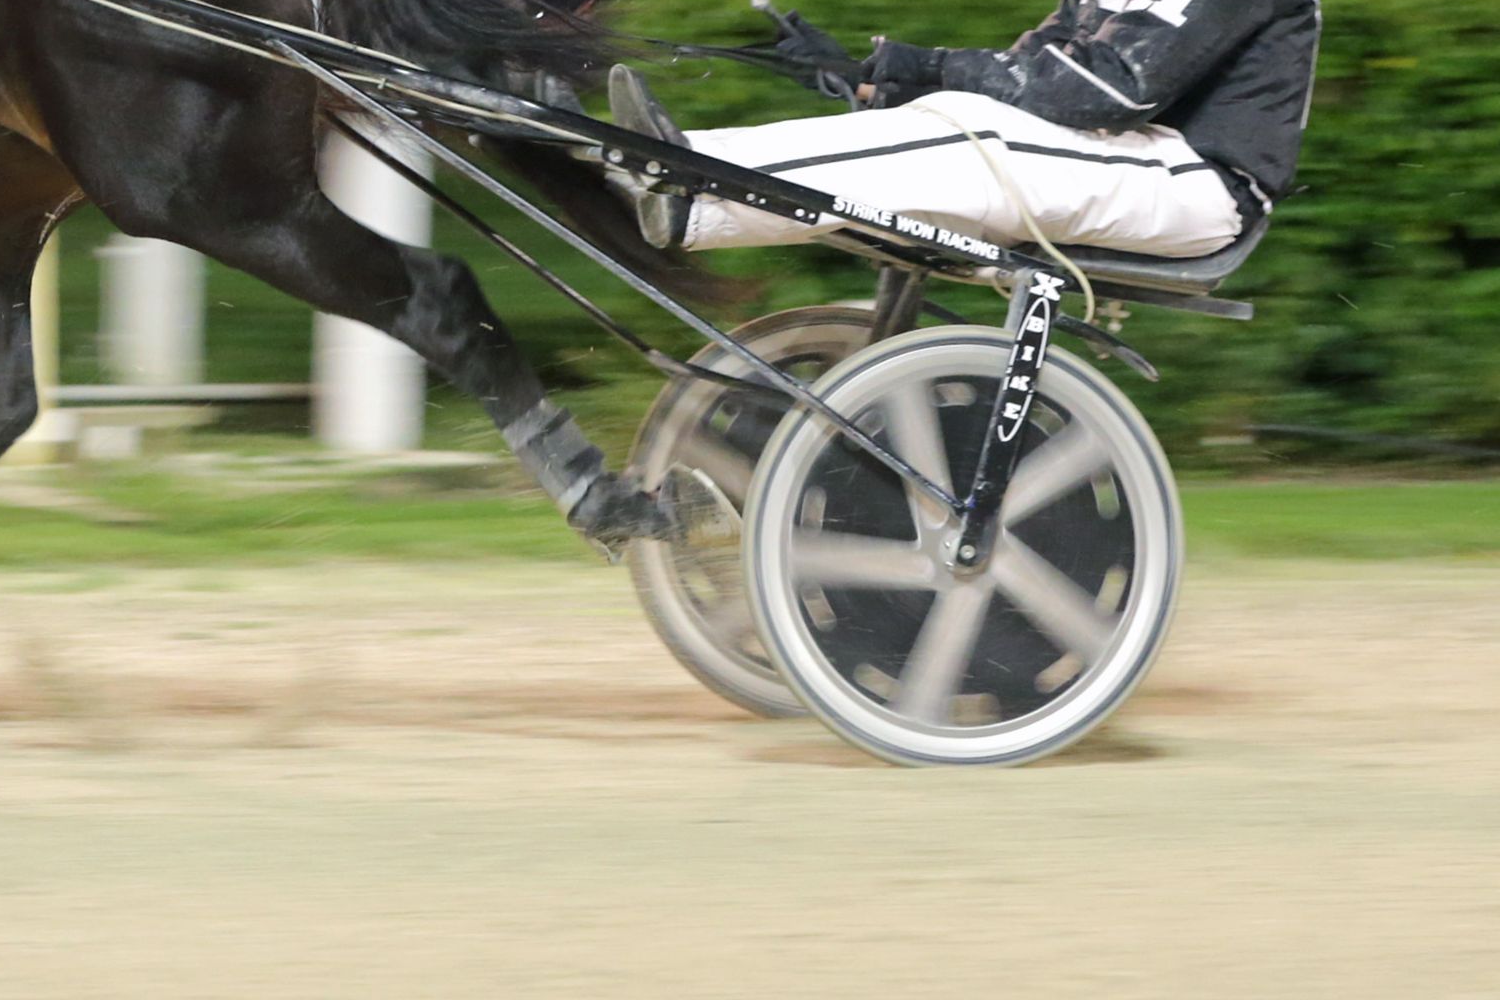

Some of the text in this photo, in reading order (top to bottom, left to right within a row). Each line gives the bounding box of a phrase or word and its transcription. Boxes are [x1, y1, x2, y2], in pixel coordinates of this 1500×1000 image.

[832, 196, 1000, 261] STRIKE WON RACING
[1002, 315, 1045, 421] BIKE
